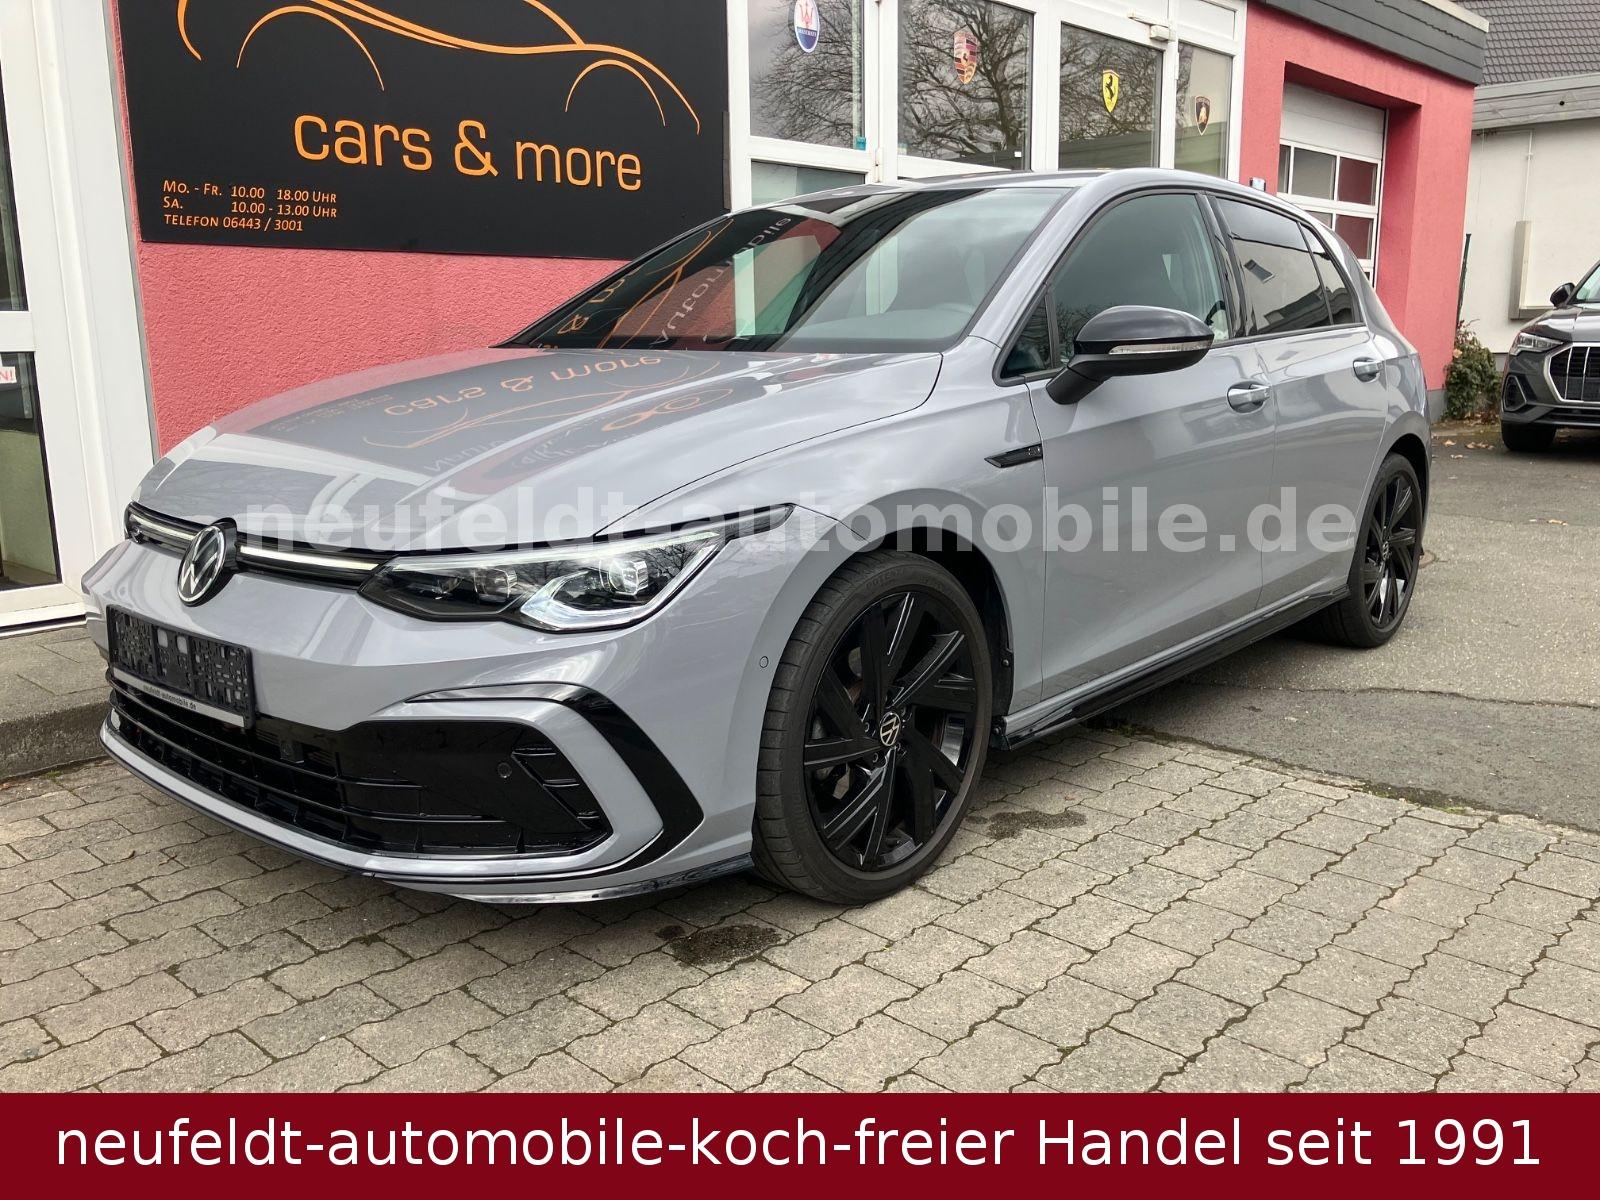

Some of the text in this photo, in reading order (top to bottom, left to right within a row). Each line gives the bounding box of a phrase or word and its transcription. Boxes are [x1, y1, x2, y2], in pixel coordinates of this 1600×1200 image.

[294, 114, 642, 191] cars & more
[231, 186, 265, 199] 10.00
[277, 189, 309, 202] 18.00
[231, 201, 265, 214] 10.00
[277, 204, 309, 216] 13.00
[164, 214, 303, 232] TELEFON 06443 / 3001
